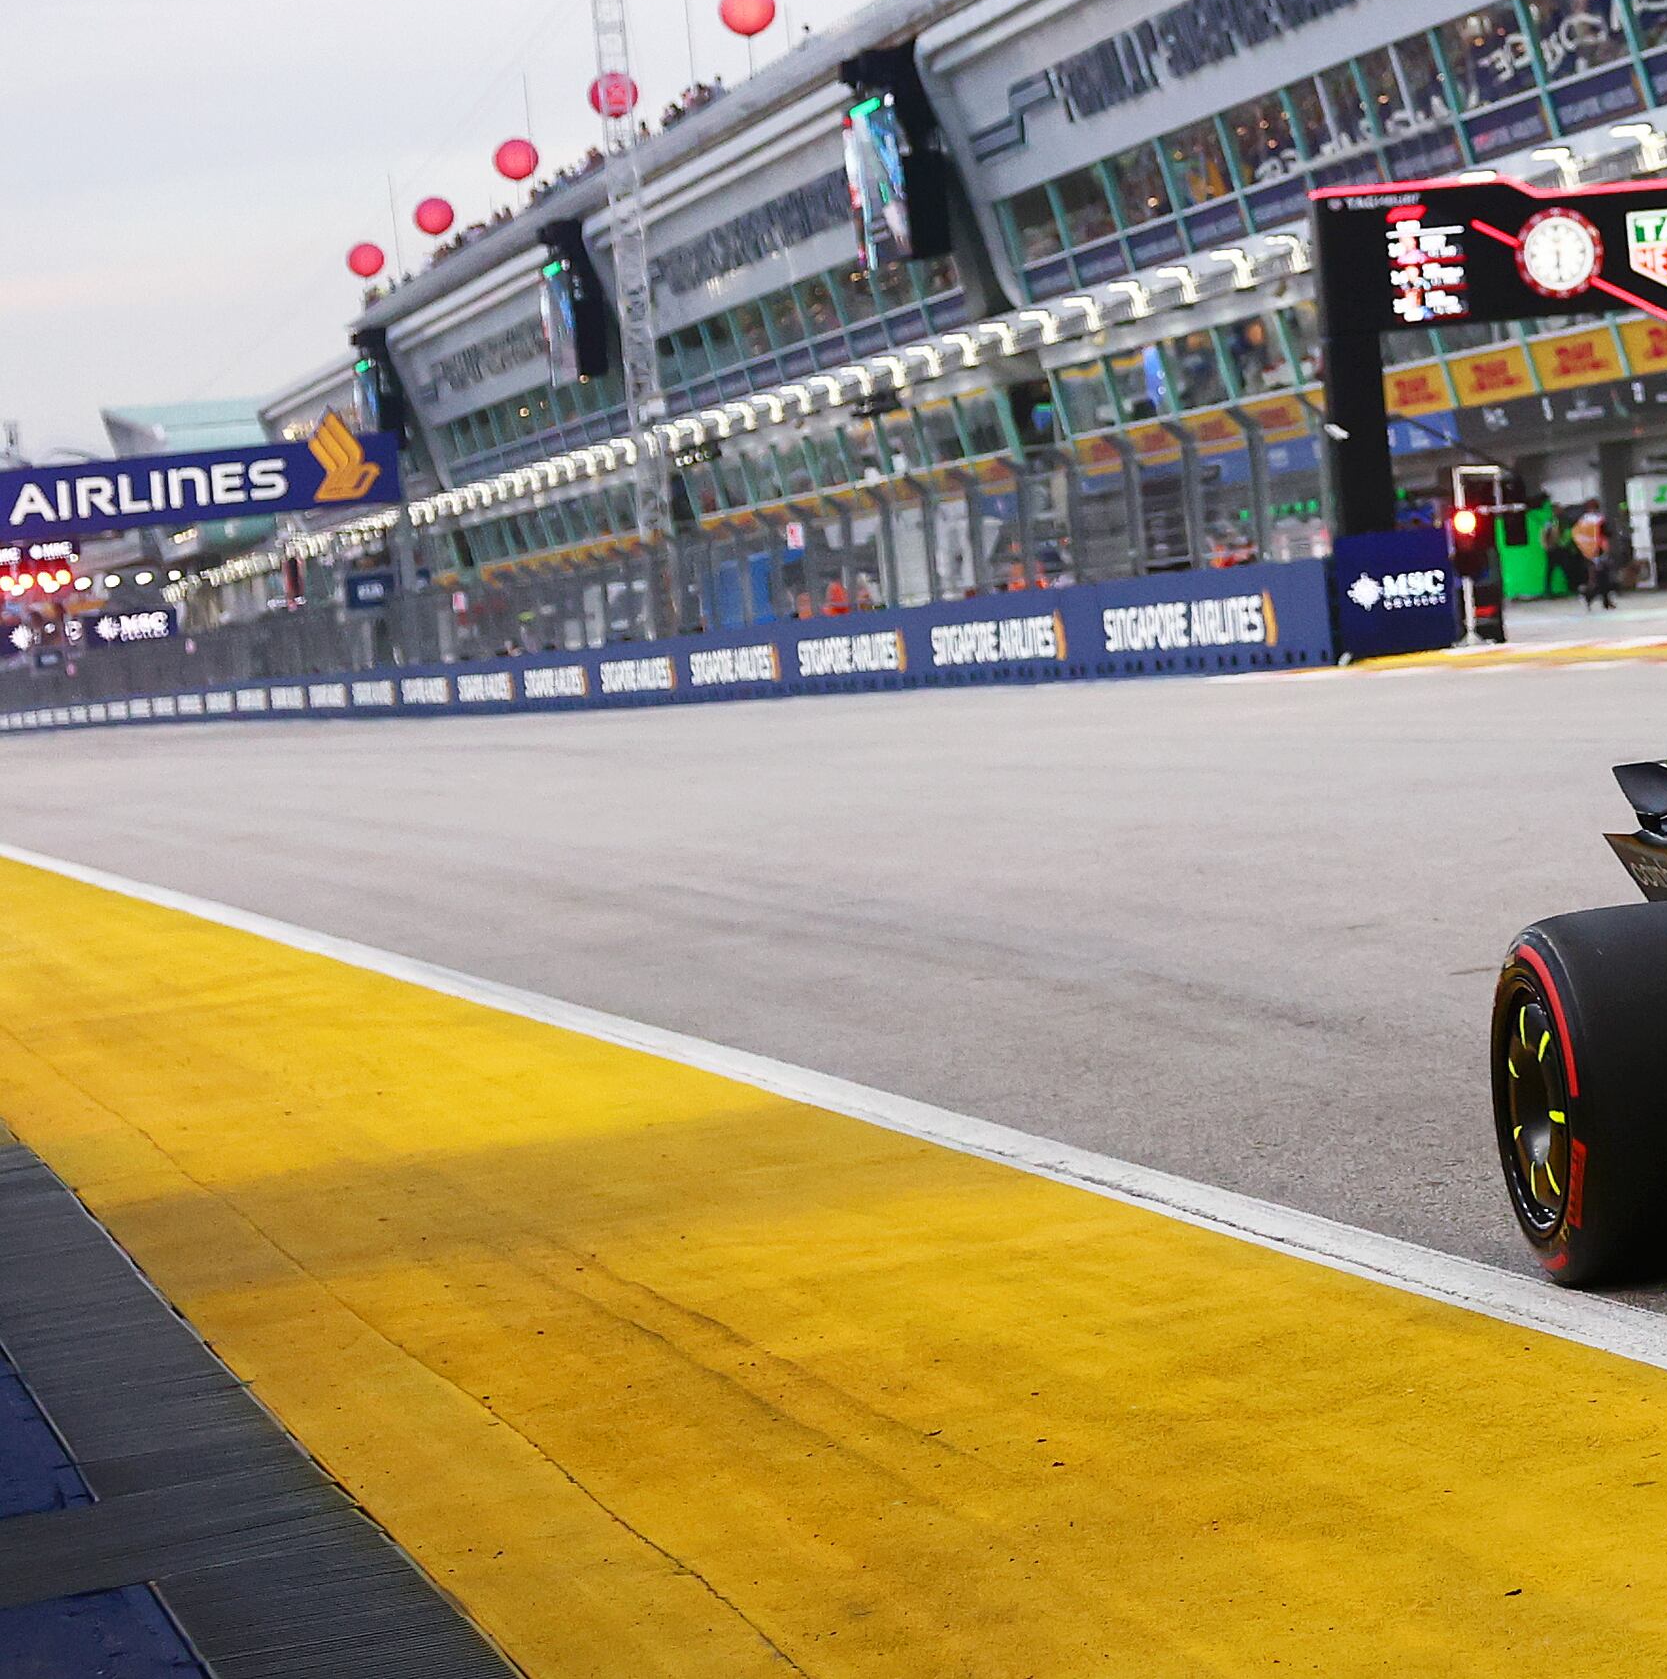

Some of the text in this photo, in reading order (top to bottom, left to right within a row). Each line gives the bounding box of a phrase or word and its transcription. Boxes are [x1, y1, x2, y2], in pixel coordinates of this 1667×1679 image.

[7, 457, 289, 524] AIRLINES
[1382, 569, 1445, 597] MSC
[931, 615, 1058, 666] SINGAPORE AIRLINES
[1103, 594, 1265, 653] SINGAPORE AIRLINES
